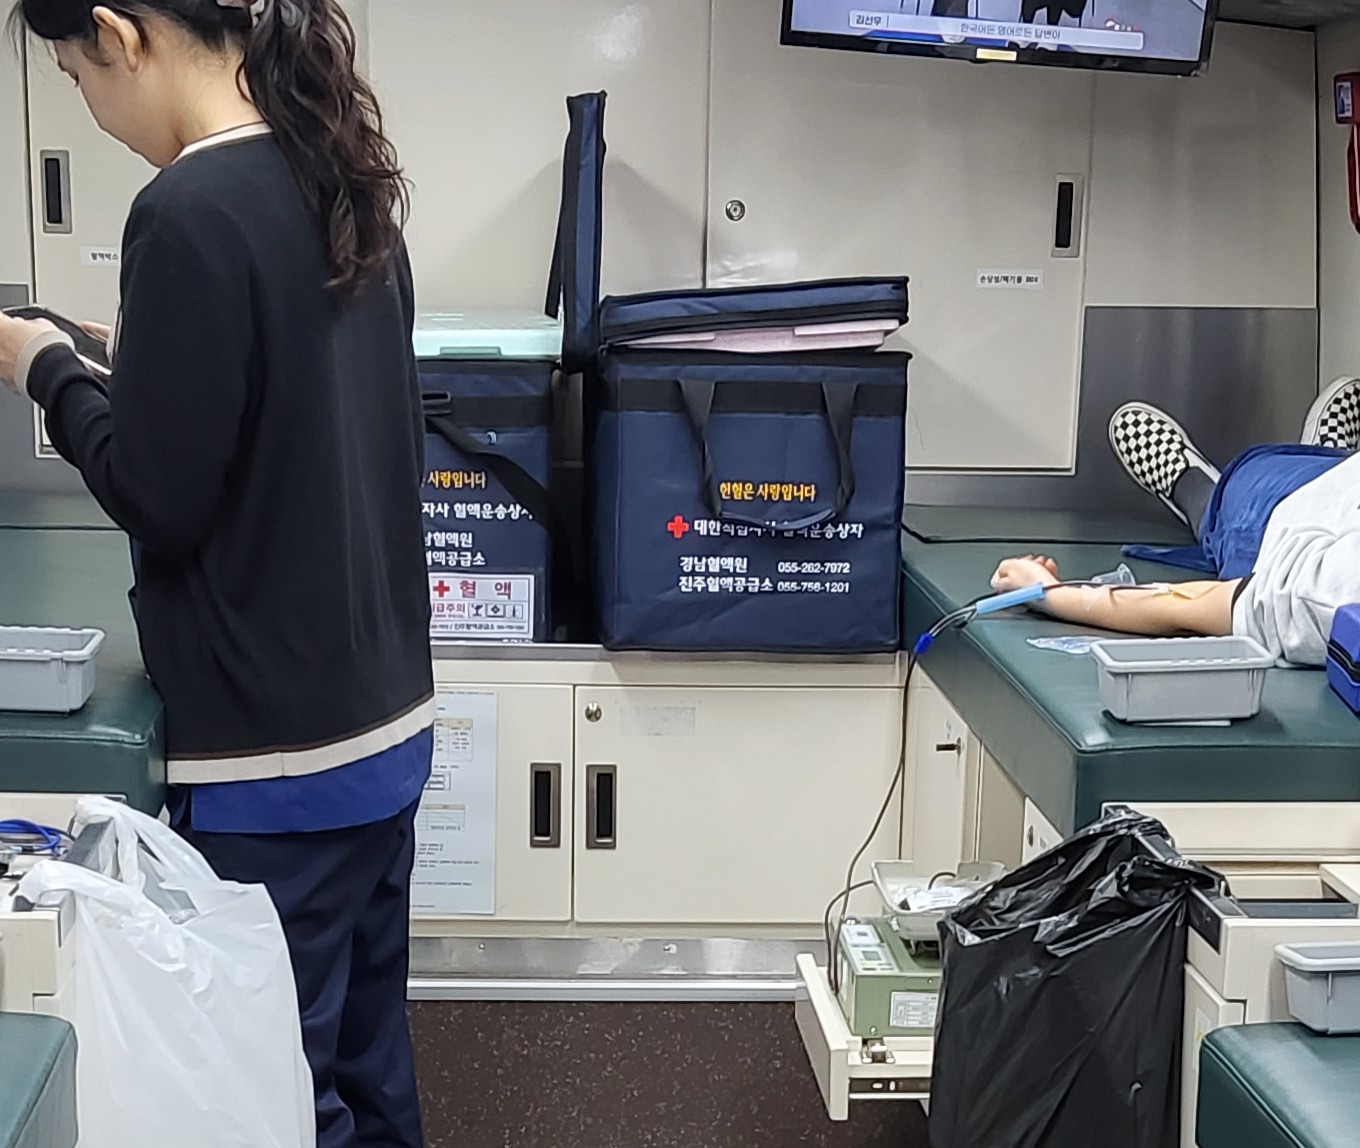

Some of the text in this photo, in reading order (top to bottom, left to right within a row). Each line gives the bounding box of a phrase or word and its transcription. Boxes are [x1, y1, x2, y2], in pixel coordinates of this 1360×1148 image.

[427, 470, 487, 489] 사랑입니다
[719, 482, 816, 502] 헌혈은 사랑입니다
[679, 557, 748, 573] 경남혈액원
[459, 580, 512, 600] 혈 액
[679, 577, 773, 593] 진주혈액공급소
[433, 603, 466, 613] 급주의
